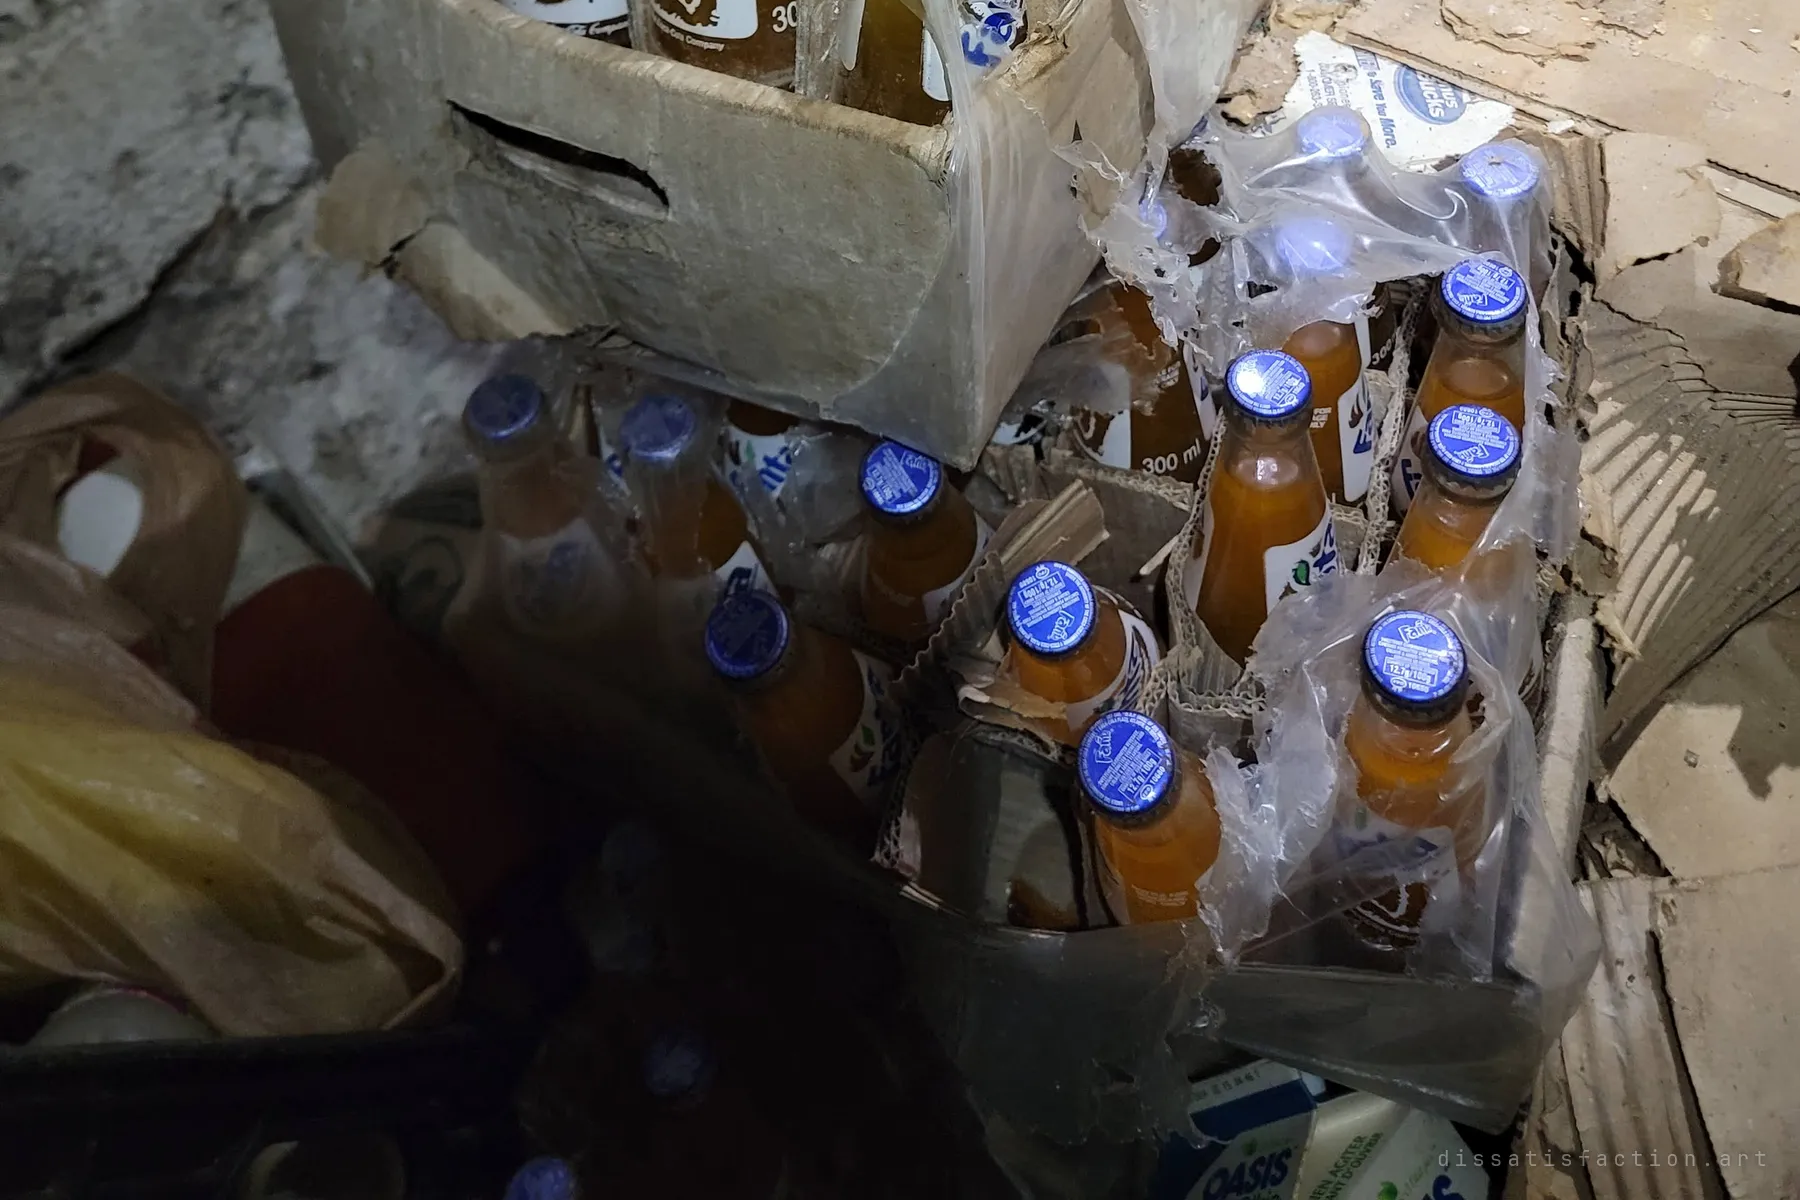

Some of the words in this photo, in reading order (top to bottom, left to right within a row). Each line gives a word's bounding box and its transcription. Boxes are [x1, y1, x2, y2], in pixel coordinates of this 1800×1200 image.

[772, 0, 799, 33] 30
[1380, 117, 1397, 149] More.
[1142, 452, 1178, 475] 300
[1183, 438, 1202, 465] ml
[1022, 577, 1058, 597] 12.7g/100g
[1126, 756, 1158, 794] 12.7g/100g
[1203, 1148, 1292, 1200] OASIS
[1328, 1135, 1368, 1178] AGITER
